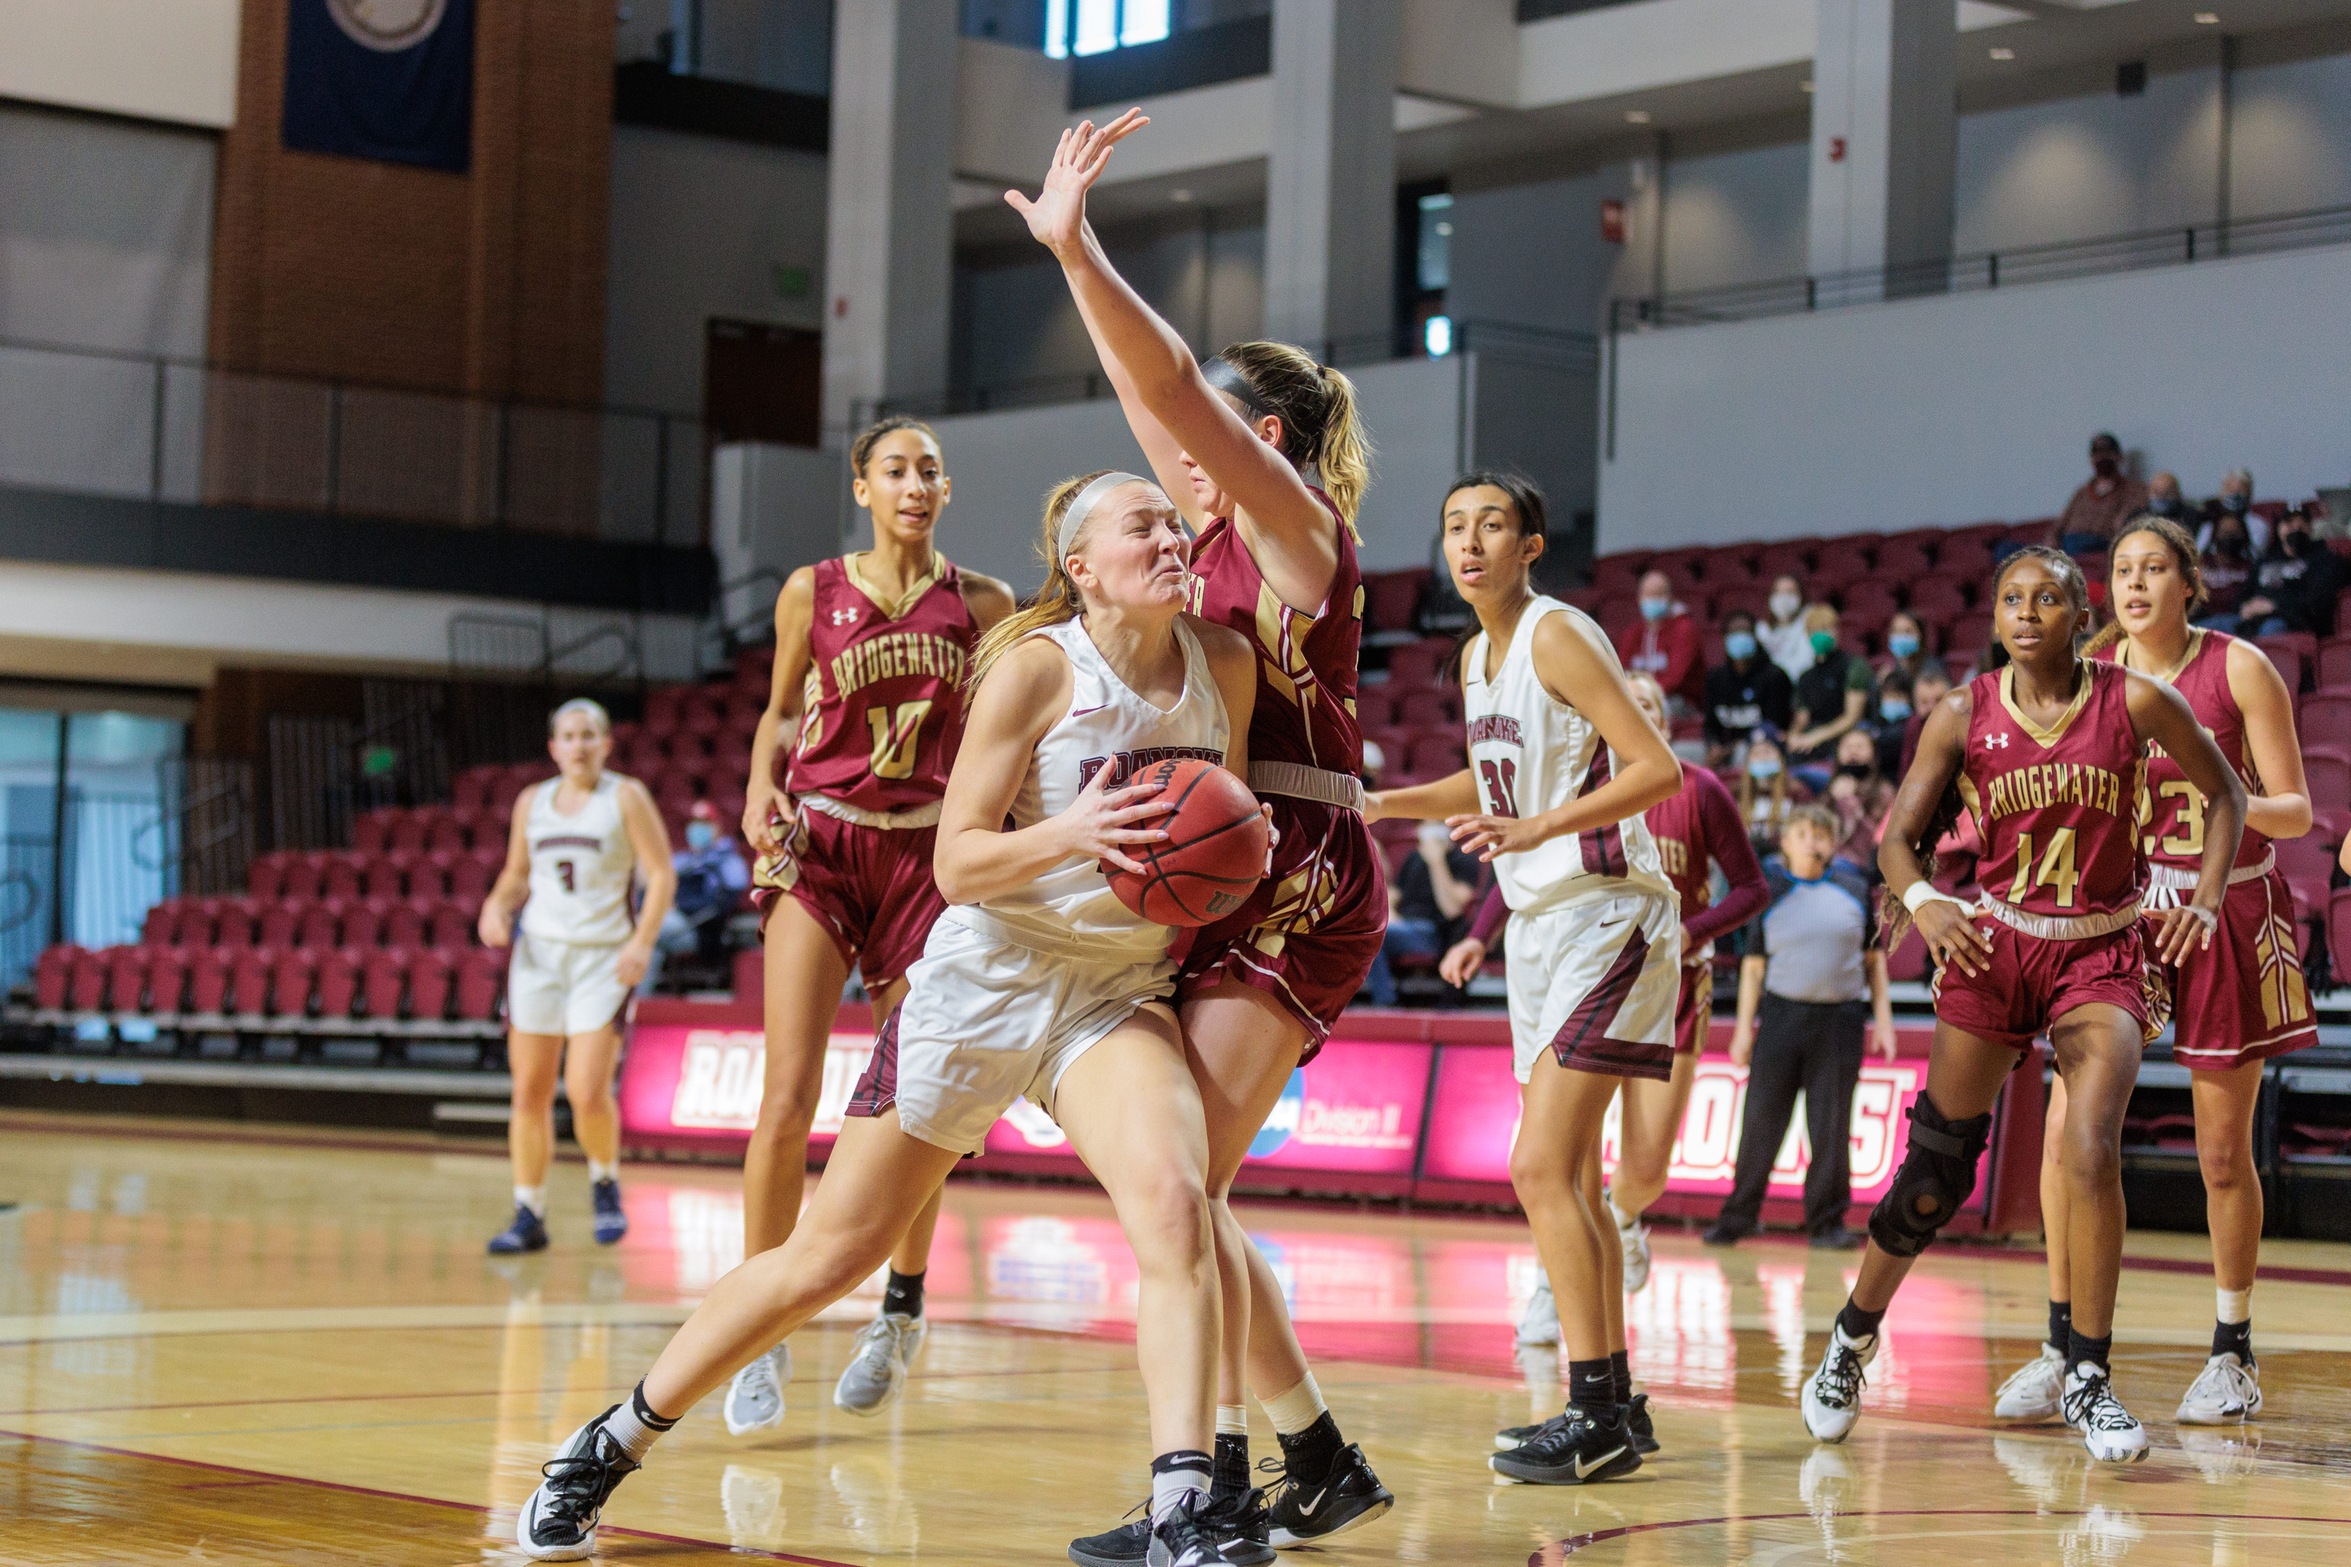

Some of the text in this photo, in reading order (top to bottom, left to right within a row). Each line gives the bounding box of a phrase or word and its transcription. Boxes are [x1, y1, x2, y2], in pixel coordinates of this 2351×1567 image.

[831, 632, 965, 703] BRIDGEWATER
[866, 699, 933, 780] 10
[1468, 714, 1524, 748] ANKE
[1988, 763, 2119, 821] BRIDGEWATER
[2007, 827, 2079, 908] 14
